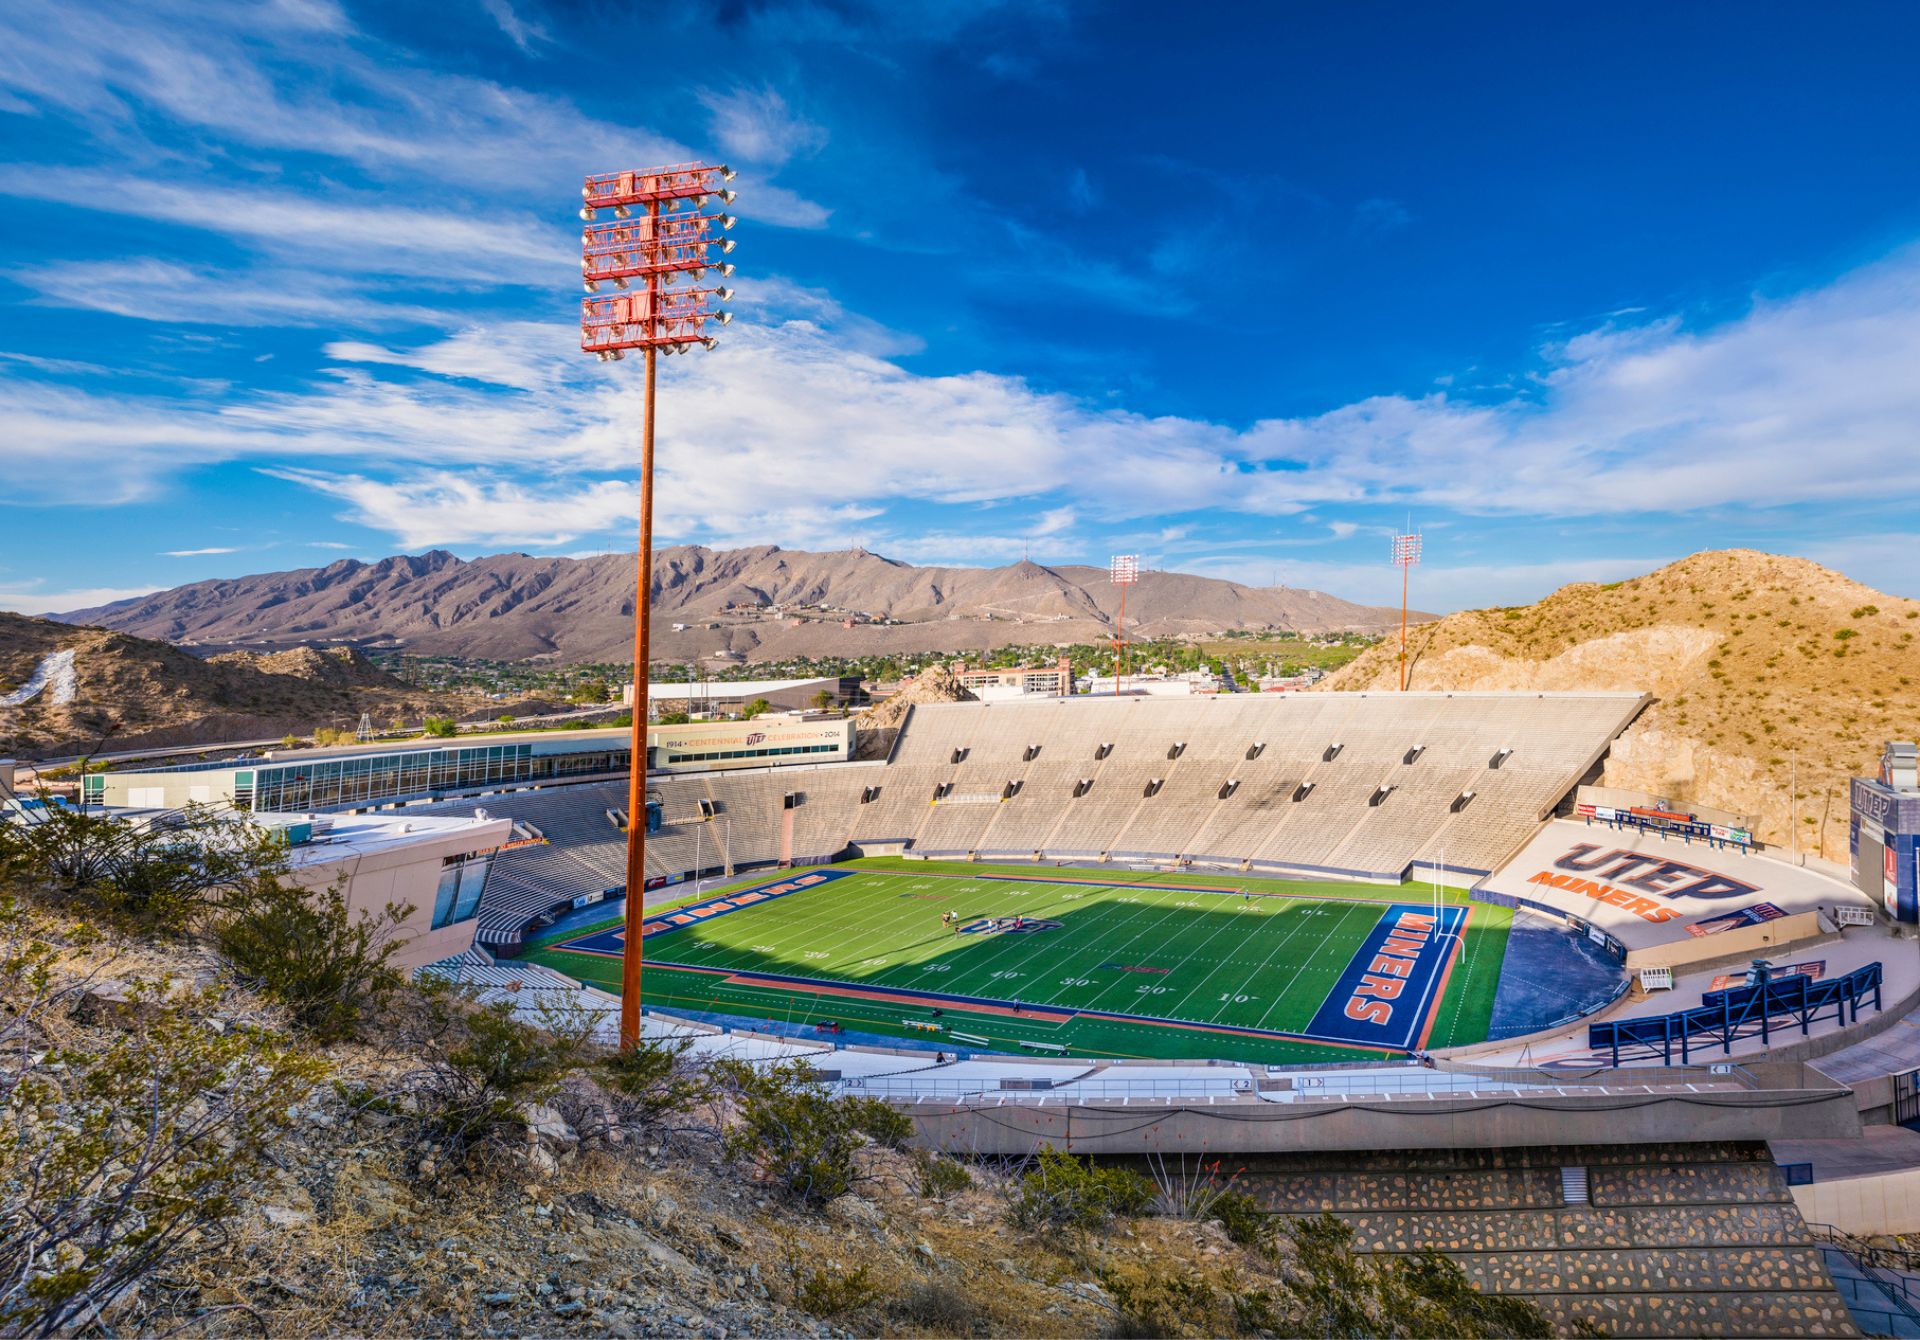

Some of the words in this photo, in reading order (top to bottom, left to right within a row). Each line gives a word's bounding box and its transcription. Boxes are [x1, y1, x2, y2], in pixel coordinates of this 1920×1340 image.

[666, 739, 682, 748] 1914
[689, 736, 744, 747] CENTENNIAL
[768, 732, 819, 742] CELEBRATION
[824, 730, 841, 738] 2014
[1854, 782, 1891, 823] UTEP
[1554, 842, 1763, 900] UTEP
[1526, 870, 1684, 924] MINERS
[922, 963, 951, 973] 50
[990, 970, 1019, 979] 40
[1344, 911, 1438, 1026] MINERS
[1059, 977, 1090, 987] 30
[1134, 984, 1167, 995] 20
[1217, 993, 1249, 1003] 10
